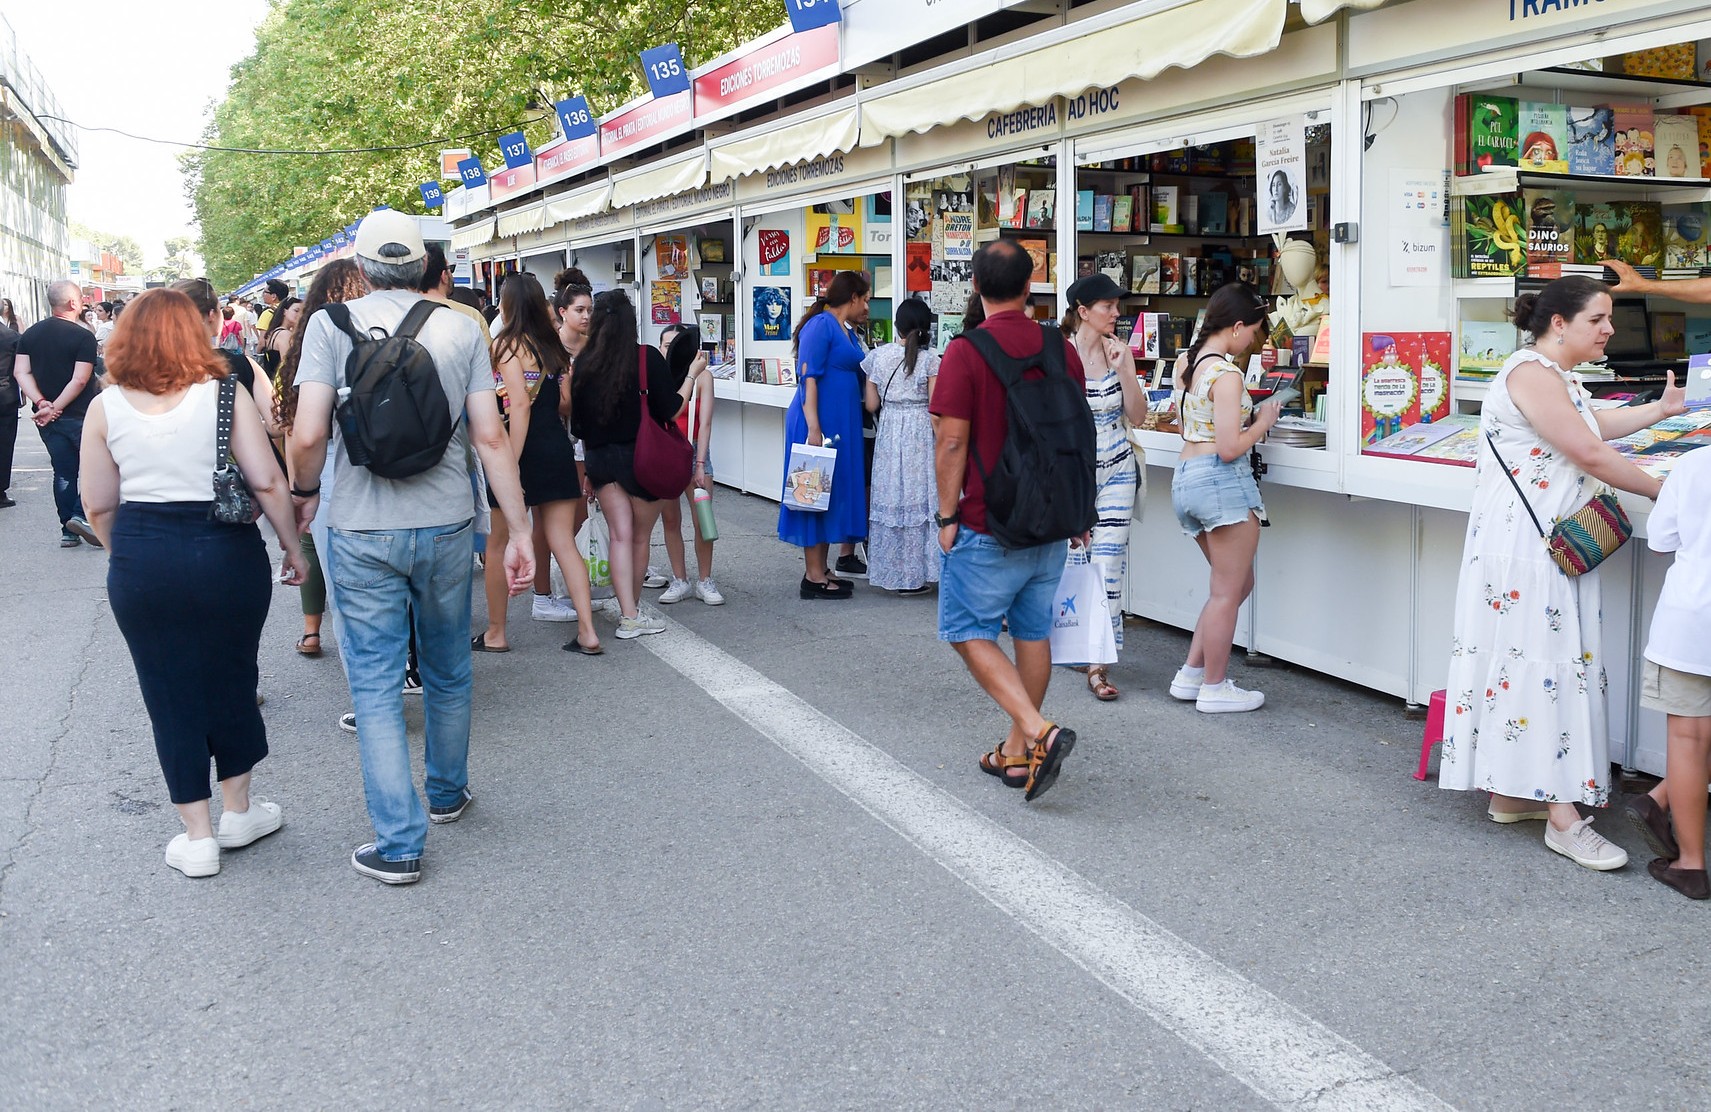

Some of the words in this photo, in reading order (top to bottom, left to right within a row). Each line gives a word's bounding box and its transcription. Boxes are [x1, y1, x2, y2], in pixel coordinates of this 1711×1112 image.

[650, 58, 681, 81] 135
[720, 68, 753, 97] EDICIONES
[753, 45, 801, 82] TORREMOZAS
[564, 108, 589, 127] 136
[987, 102, 1057, 139] CAFEBRERIA
[1067, 95, 1086, 121] AD
[1089, 86, 1120, 116] HOC
[1490, 121, 1502, 133] POL
[1478, 134, 1485, 147] EL
[1487, 135, 1514, 148] CARACOL
[506, 142, 525, 158] 137
[1269, 146, 1290, 157] Natalia
[1280, 154, 1299, 166] Freire
[463, 166, 481, 181] 138
[767, 165, 798, 189] EDICIONES
[798, 155, 844, 182] TORREMOZAS
[424, 186, 440, 200] 139
[672, 192, 693, 210] EDITORIAL
[693, 187, 711, 205] MUNDO
[712, 182, 730, 200] NEGRO
[944, 215, 972, 224] ANDRE
[945, 223, 972, 232] BRETON
[1528, 229, 1558, 240] DINO
[764, 242, 787, 262] faldas
[1412, 242, 1436, 252] bizum
[1528, 242, 1569, 252] SAURIOS
[1471, 262, 1510, 271] REPTILES
[1054, 619, 1080, 629] CaixaBank
